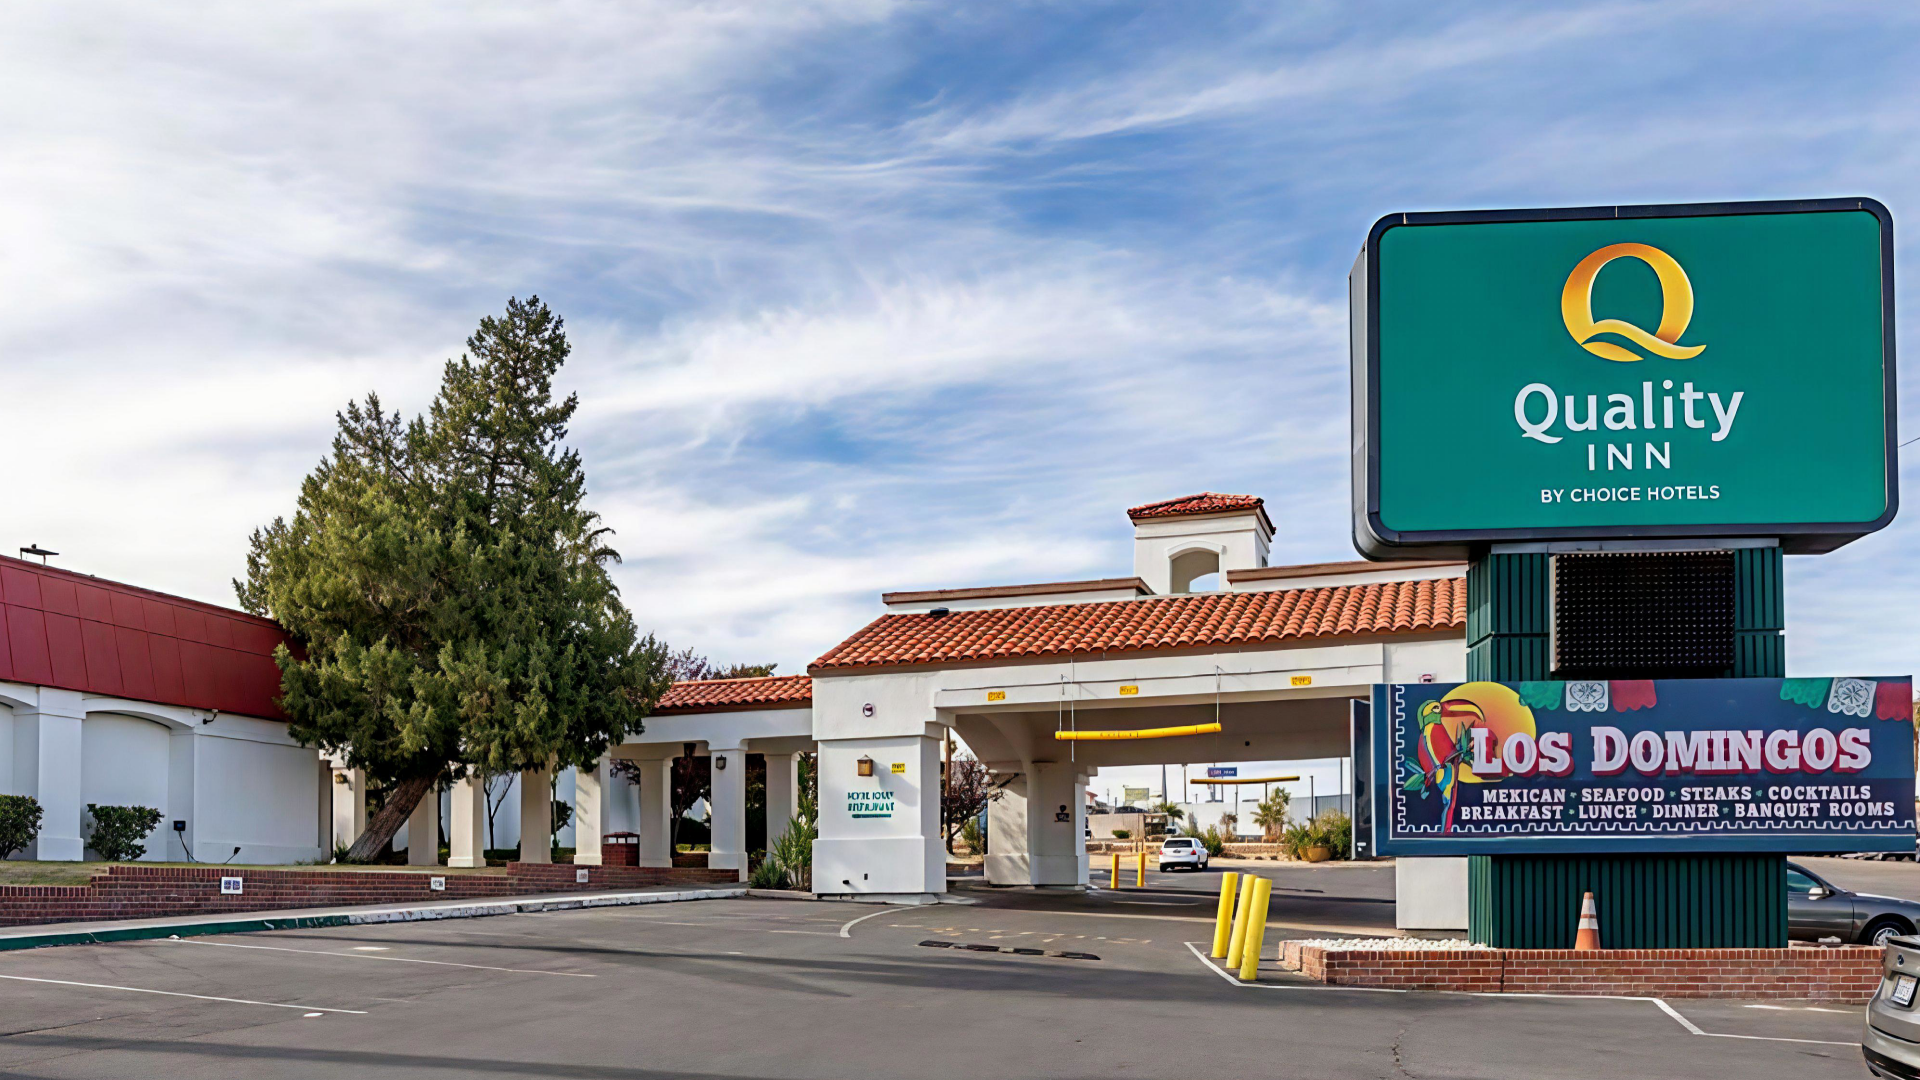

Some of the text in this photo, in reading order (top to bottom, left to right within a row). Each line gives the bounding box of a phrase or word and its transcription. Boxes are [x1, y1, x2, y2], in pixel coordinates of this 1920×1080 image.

[1561, 242, 1707, 362] Q
[1514, 379, 1745, 444] Quality
[1588, 441, 1671, 471] INN
[1541, 485, 1720, 503] BY CHOICE HOTELS
[1470, 726, 1873, 775] LOS DOMINGOS
[1482, 785, 1871, 803] MEXICAN SEAFOOD STEAKS COCKTAILS
[1460, 801, 1895, 820] BREAKFAST LUNCH DINNER BANQUET ROOMS
